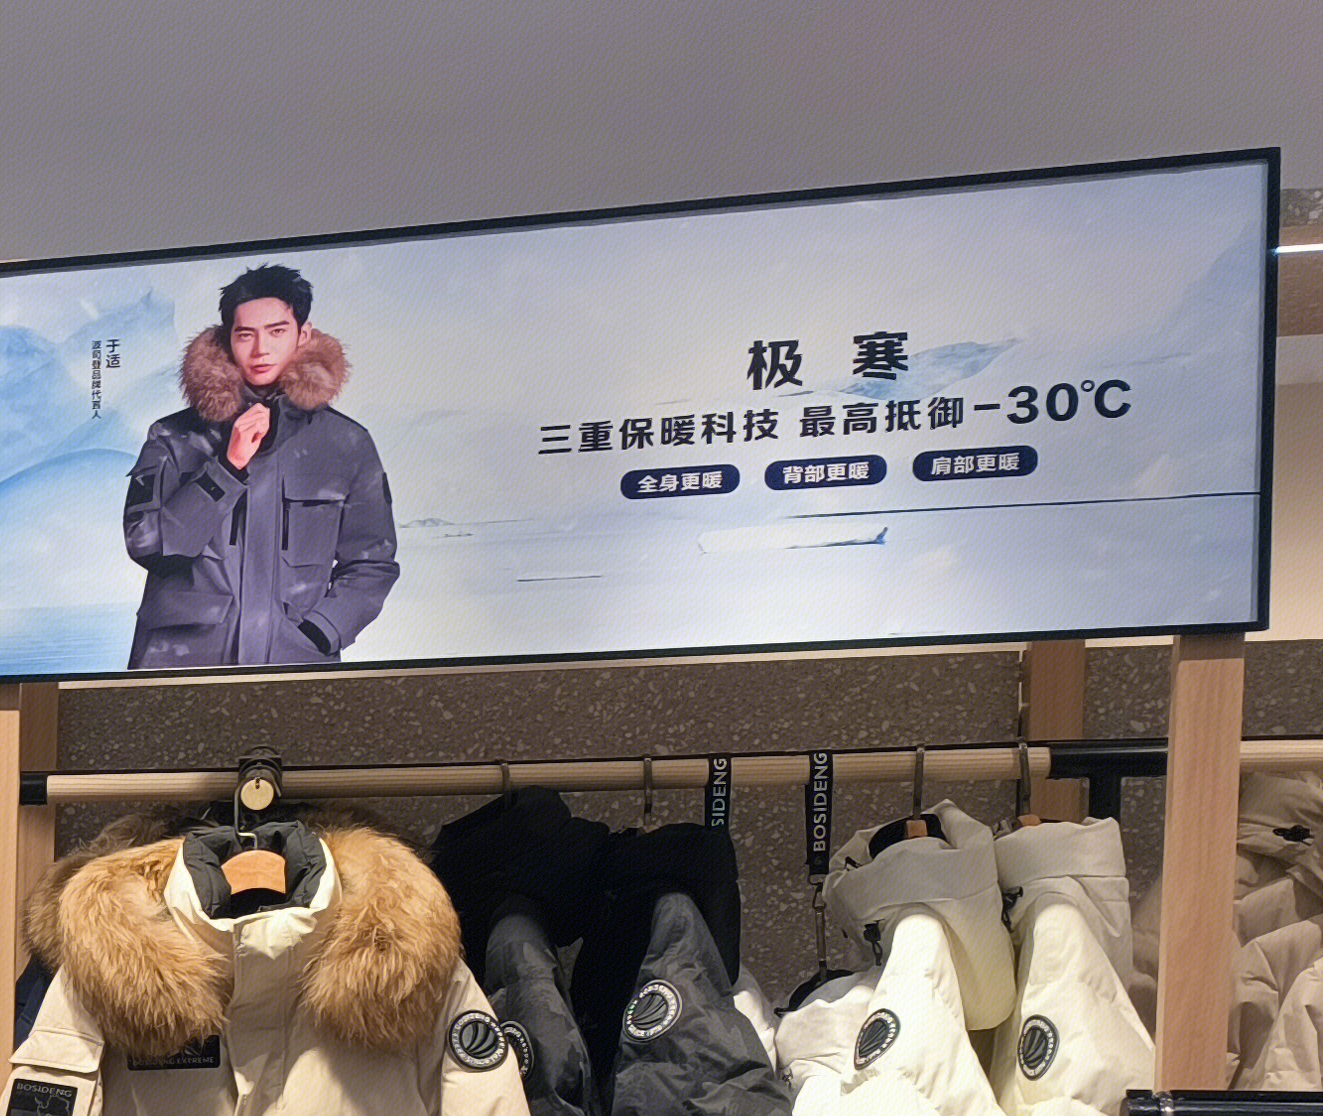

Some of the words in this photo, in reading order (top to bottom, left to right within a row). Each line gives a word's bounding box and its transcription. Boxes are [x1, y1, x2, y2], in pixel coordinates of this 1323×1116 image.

[746, 330, 909, 390] 极寒
[538, 408, 779, 455] 三重保暖科技
[783, 461, 870, 485] 背部更暖
[930, 451, 1021, 476] 肩部更暖
[636, 471, 723, 493] 全身更暖
[813, 752, 828, 851] BOSIDENG
[16, 1082, 73, 1098] BOSIDENG
